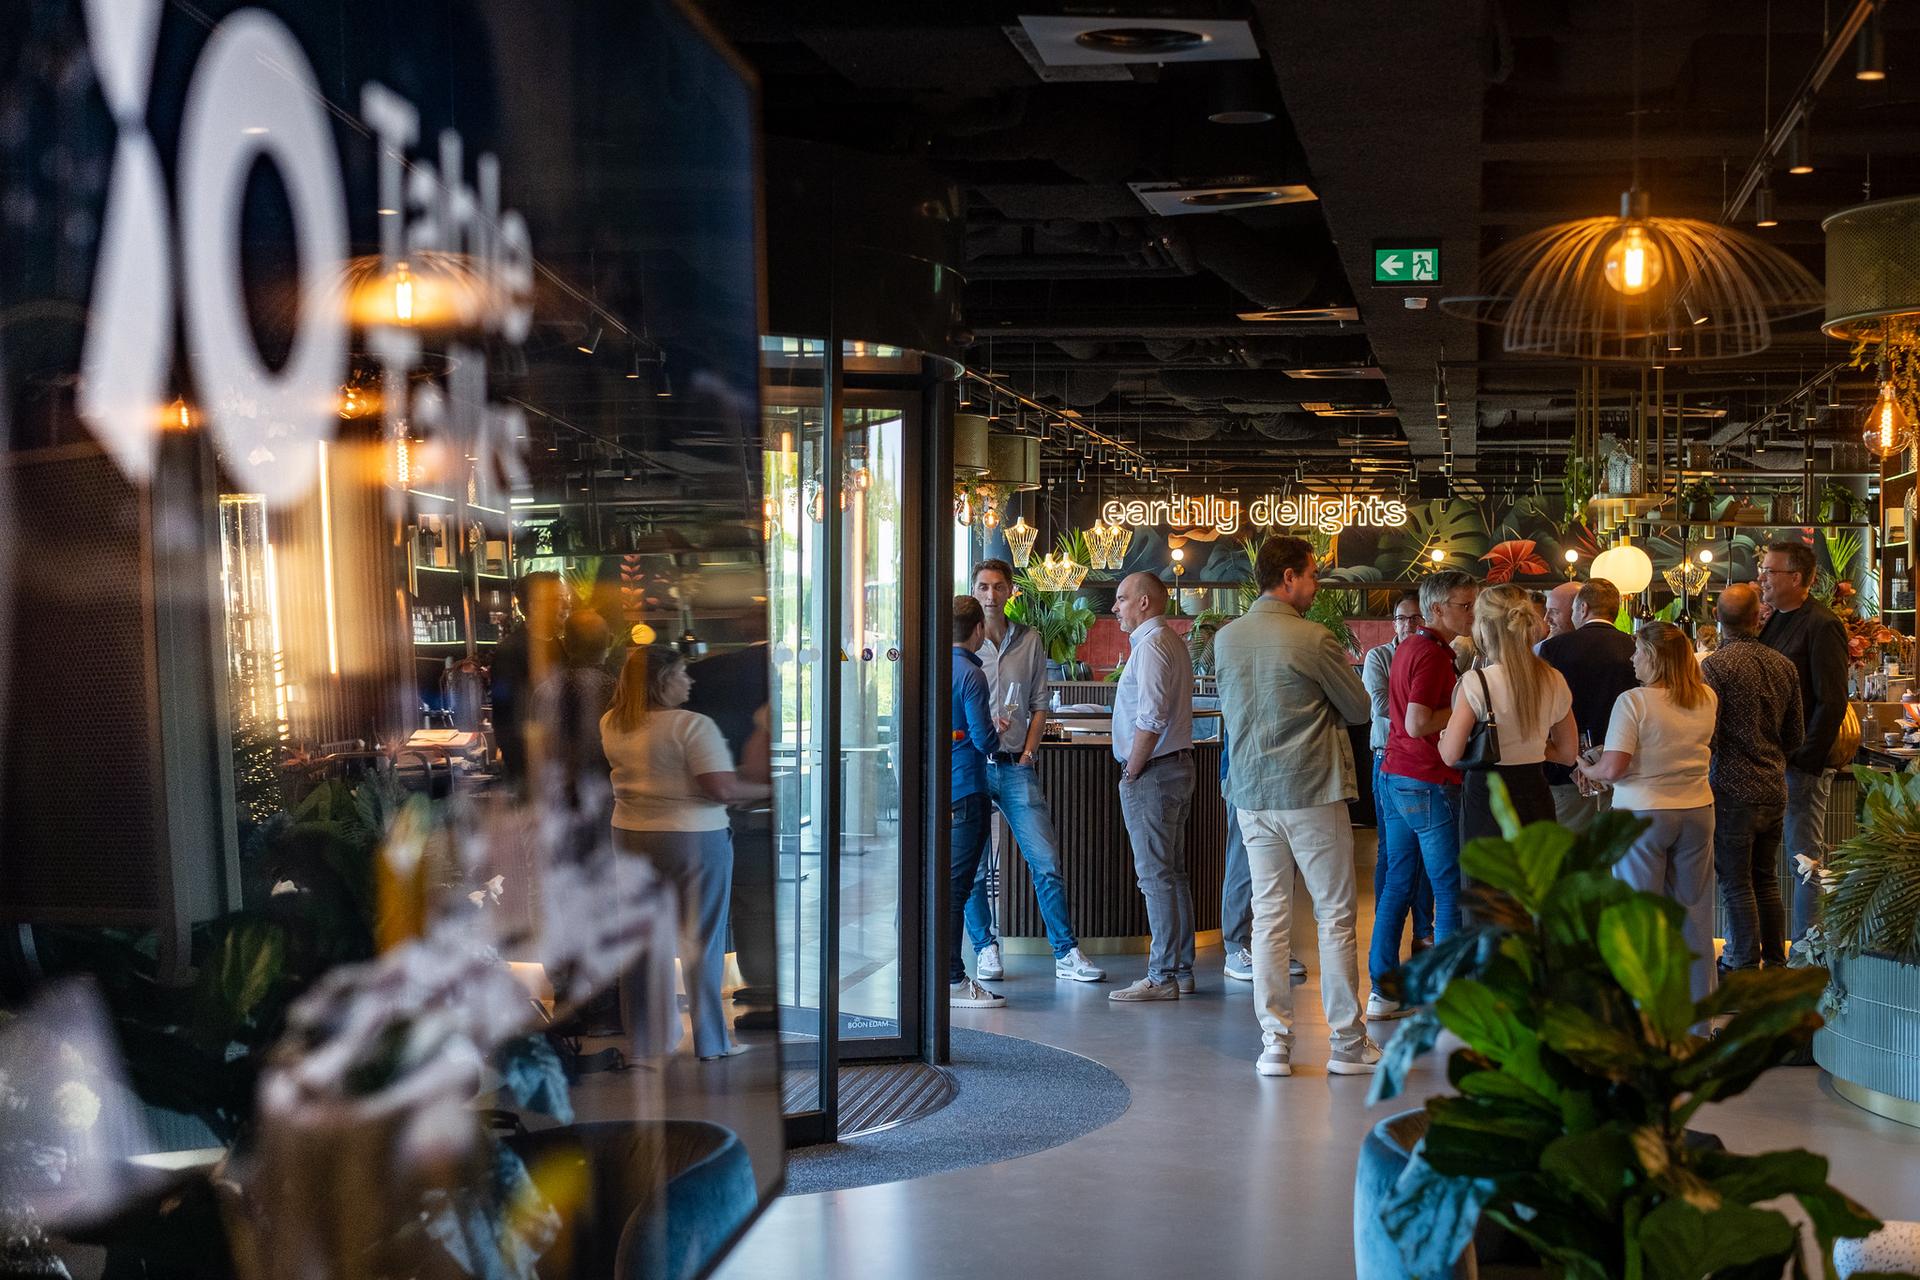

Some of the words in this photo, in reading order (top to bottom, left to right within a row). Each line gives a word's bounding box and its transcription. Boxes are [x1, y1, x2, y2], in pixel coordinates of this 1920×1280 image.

[1102, 495, 1240, 535] earthly
[1249, 495, 1408, 535] delights
[847, 1021, 868, 1029] BOON
[869, 1020, 889, 1028] EDAM
